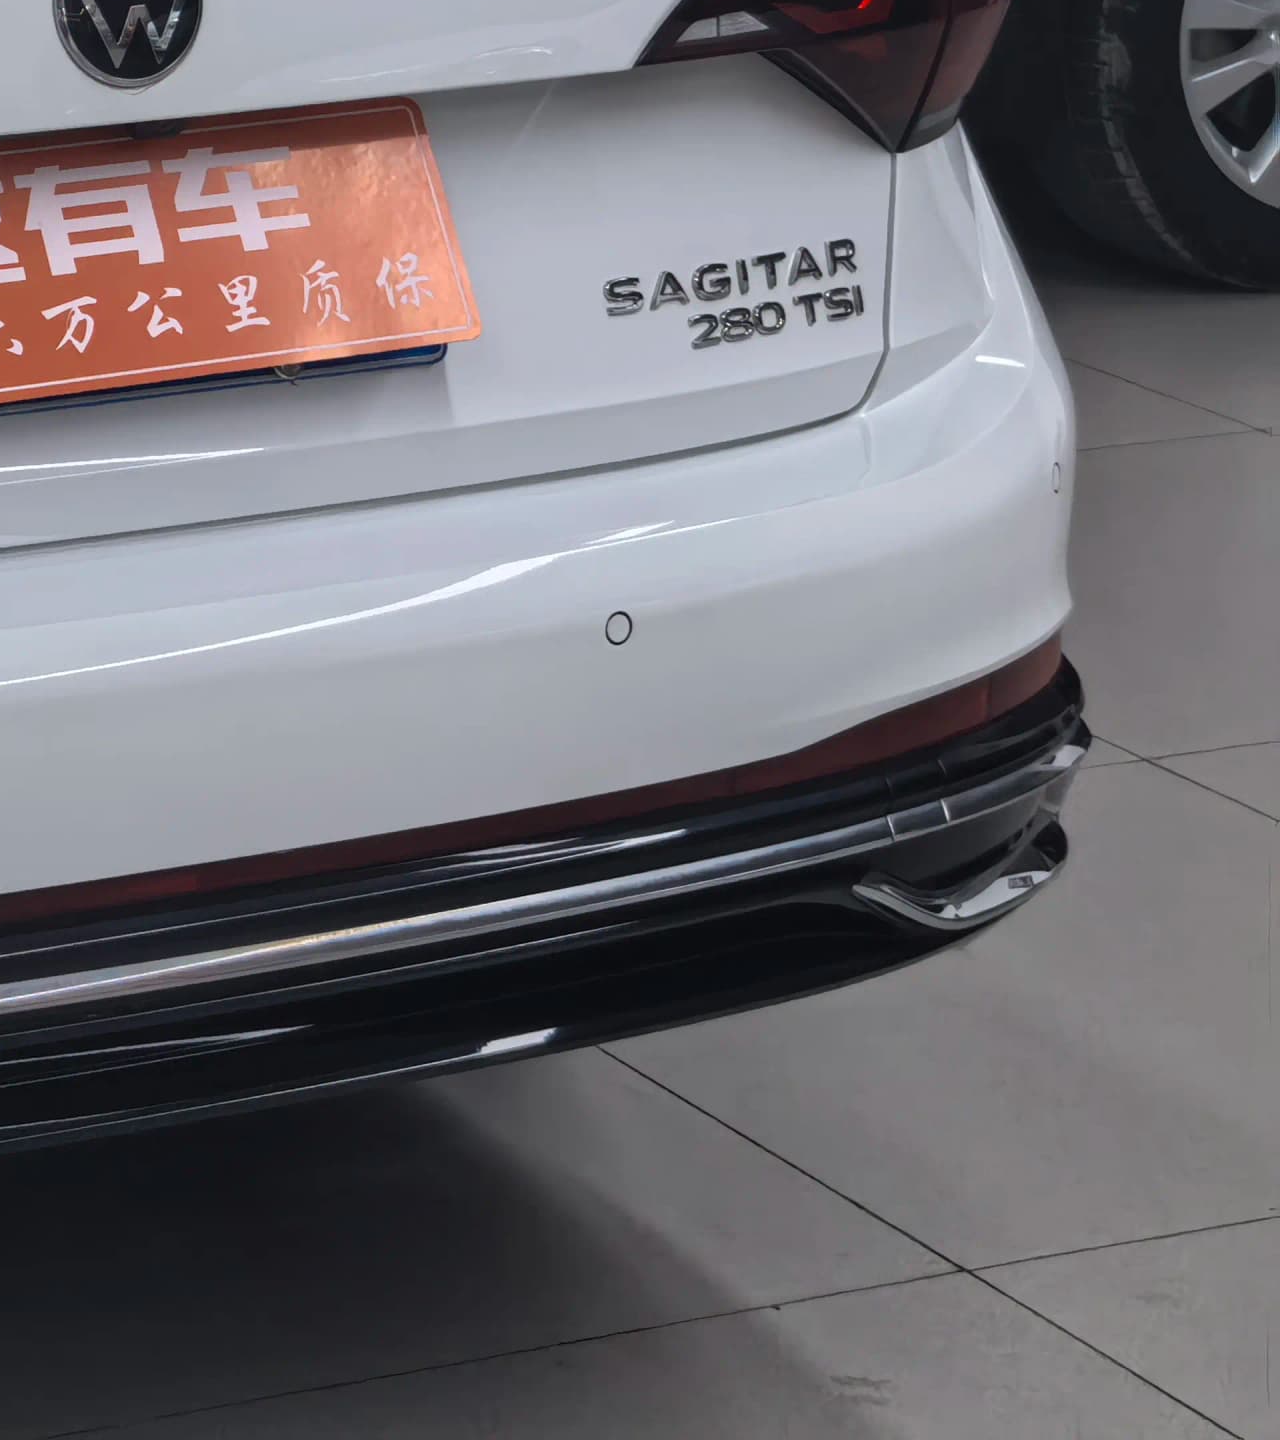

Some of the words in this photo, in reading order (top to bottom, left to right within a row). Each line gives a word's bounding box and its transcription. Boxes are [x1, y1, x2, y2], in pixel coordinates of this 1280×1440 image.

[602, 238, 857, 317] SAGITAR
[687, 301, 786, 350] 280
[792, 284, 864, 327] TSI
